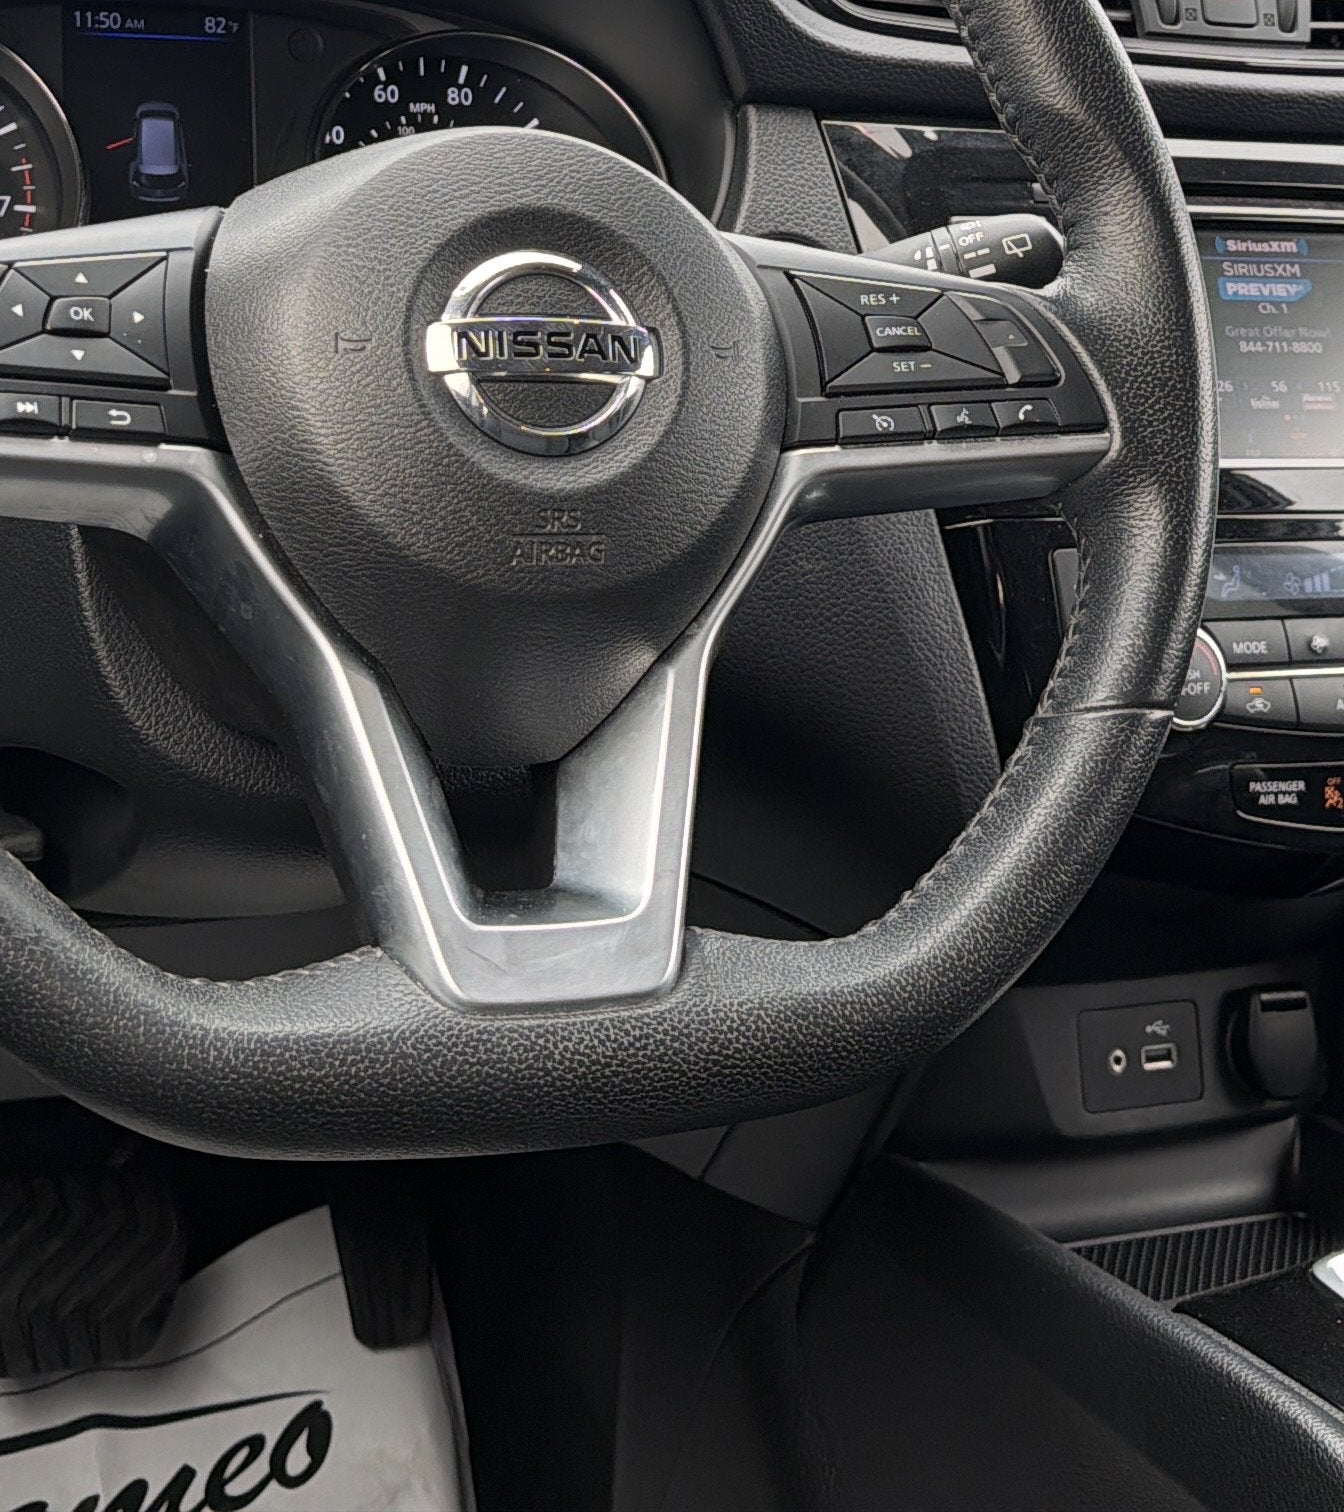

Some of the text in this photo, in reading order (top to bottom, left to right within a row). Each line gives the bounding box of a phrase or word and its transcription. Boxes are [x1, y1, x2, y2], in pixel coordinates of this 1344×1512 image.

[74, 11, 145, 30] 11:50 AM
[374, 84, 399, 104] 60
[447, 87, 473, 106] 80
[409, 102, 436, 113] MPH
[959, 232, 984, 246] OFF
[1222, 261, 1301, 277] SIRIUSXM
[1225, 282, 1304, 297] PREVIEW
[860, 293, 886, 306] RES
[70, 306, 94, 321] OK
[876, 326, 922, 337] CANCEL
[456, 330, 640, 364] NISSAN
[892, 360, 916, 373] SET
[1271, 380, 1288, 393] 56
[1318, 381, 1341, 393] 115
[535, 508, 583, 531] SRS
[512, 540, 606, 567] AIRBAG
[1232, 640, 1268, 654] MODE
[1249, 777, 1343, 793] PASSENGER OFF
[1258, 793, 1298, 805] AIR BAG
